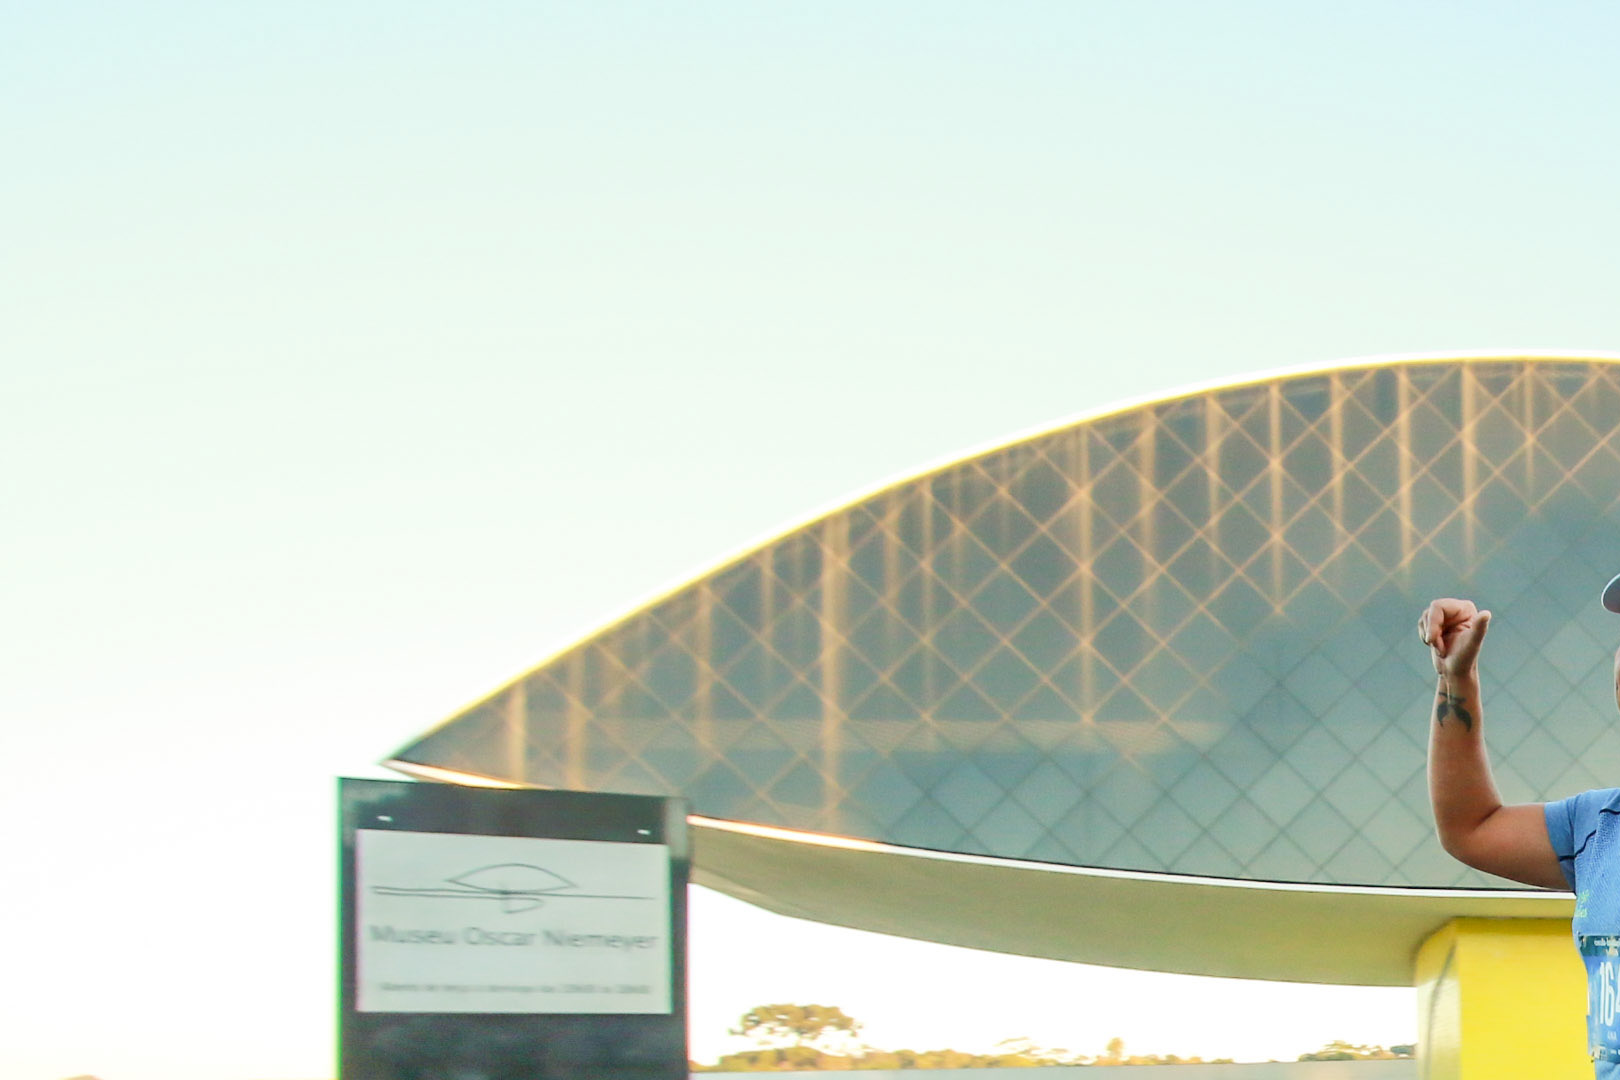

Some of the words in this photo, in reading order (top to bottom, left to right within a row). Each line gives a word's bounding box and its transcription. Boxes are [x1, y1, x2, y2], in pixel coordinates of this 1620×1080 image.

[369, 925, 458, 944] Museu
[463, 926, 537, 946] Oscar
[541, 928, 659, 951] Niemeyer
